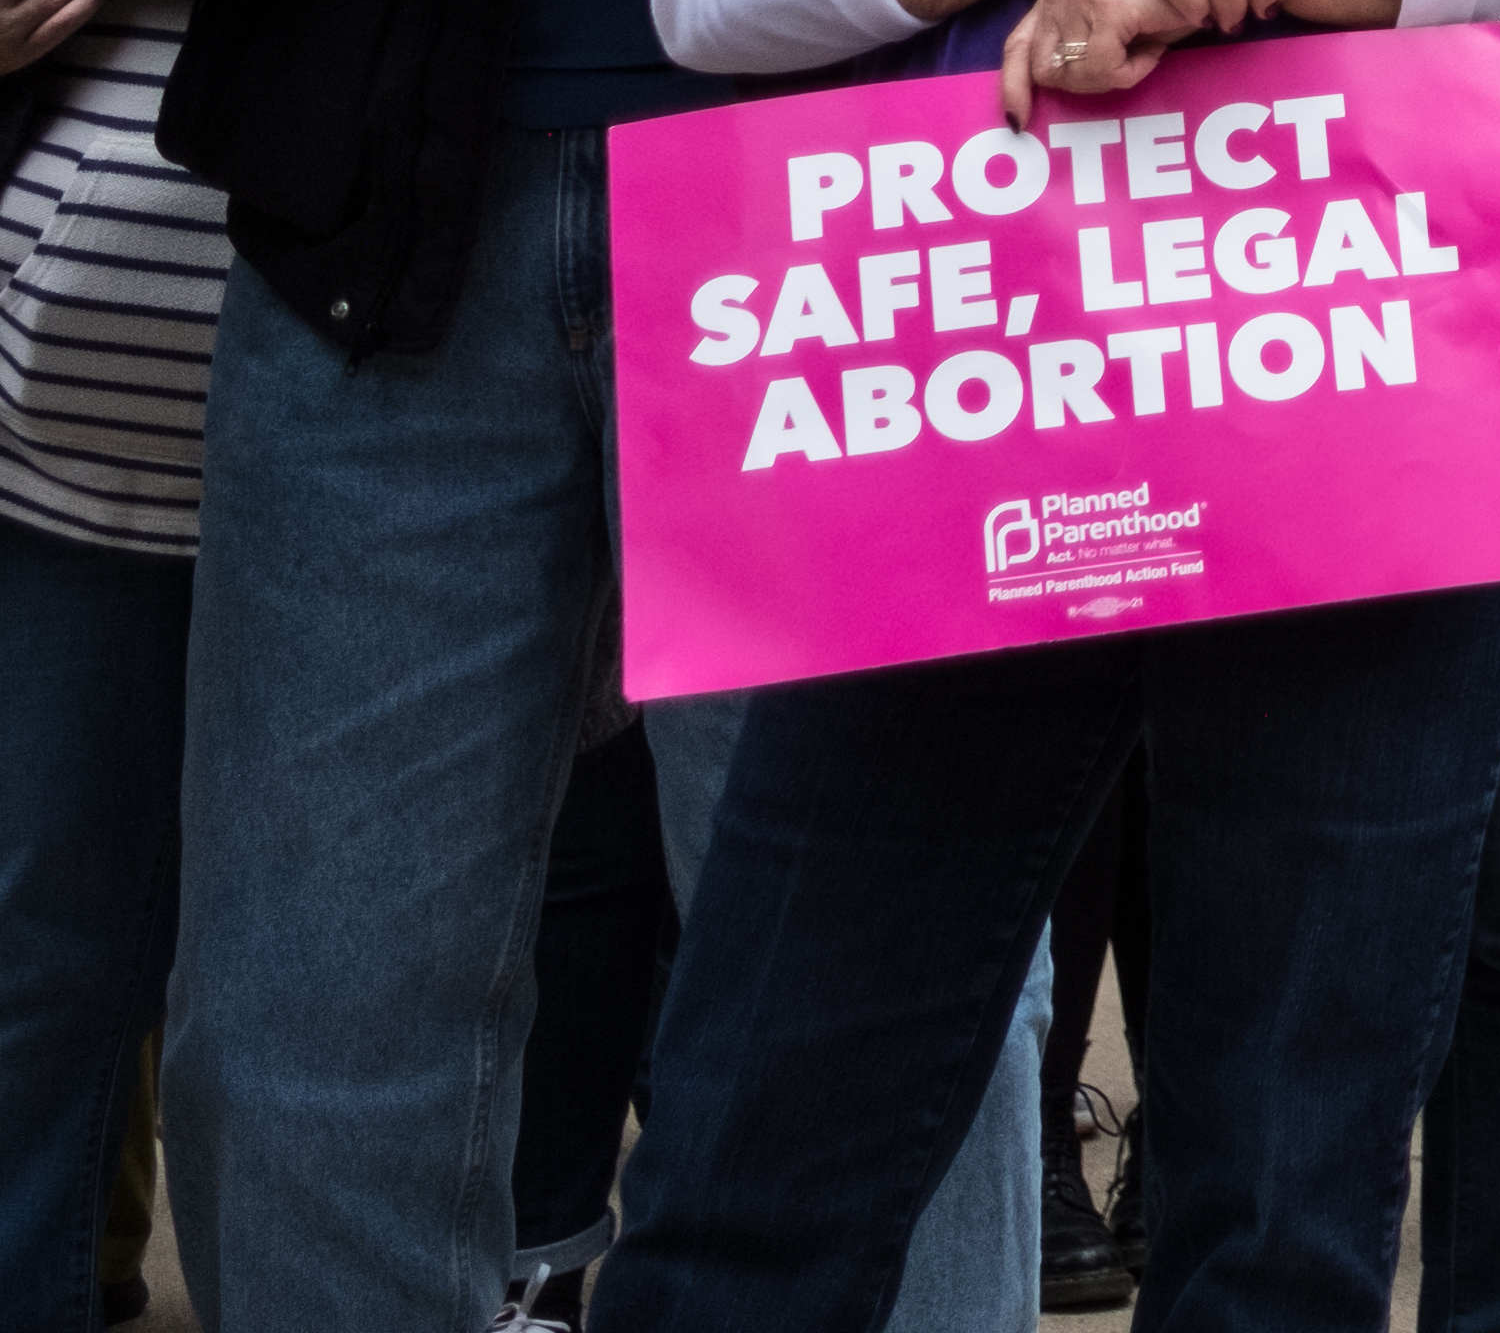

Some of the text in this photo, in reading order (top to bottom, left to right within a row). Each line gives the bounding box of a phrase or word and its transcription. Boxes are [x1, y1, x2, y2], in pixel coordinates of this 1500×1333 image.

[787, 92, 1347, 243] PROTECT
[689, 190, 1459, 367] SAFE, LEGAL
[740, 299, 1418, 473] ABORTION
[1042, 482, 1149, 519] Planned
[988, 559, 1204, 603] Planned Parenthood Action Fund
[1046, 551, 1075, 565] Act.
[1078, 548, 1098, 560] No
[1099, 542, 1140, 557] matter
